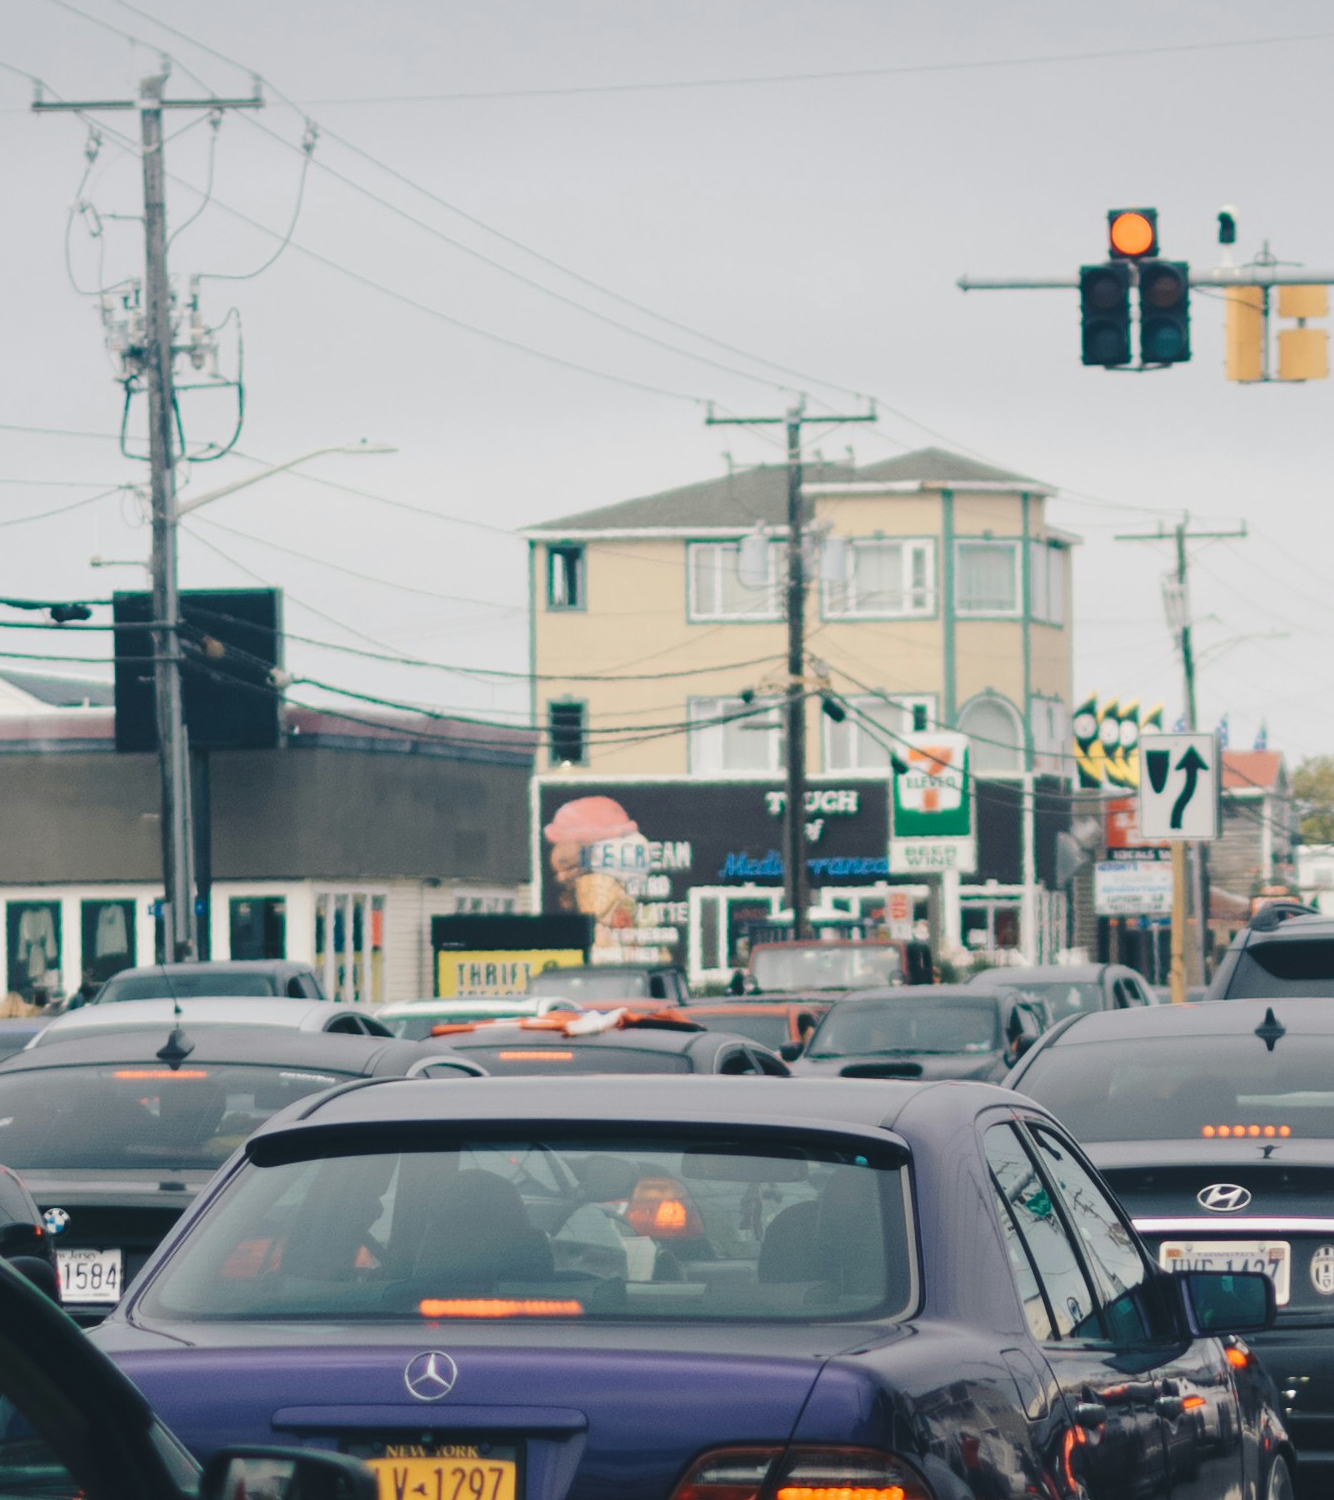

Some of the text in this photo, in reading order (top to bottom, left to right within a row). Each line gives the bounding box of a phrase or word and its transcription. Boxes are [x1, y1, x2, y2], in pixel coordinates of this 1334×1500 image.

[766, 791, 859, 815] TUCH
[579, 841, 692, 869] ICE CREAM
[905, 846, 957, 856] BEER
[906, 856, 955, 867] WINE
[636, 902, 689, 925] LATTE
[457, 963, 532, 986] THRIFT
[64, 1262, 117, 1290] 1584
[386, 1444, 479, 1458] NEW YORK
